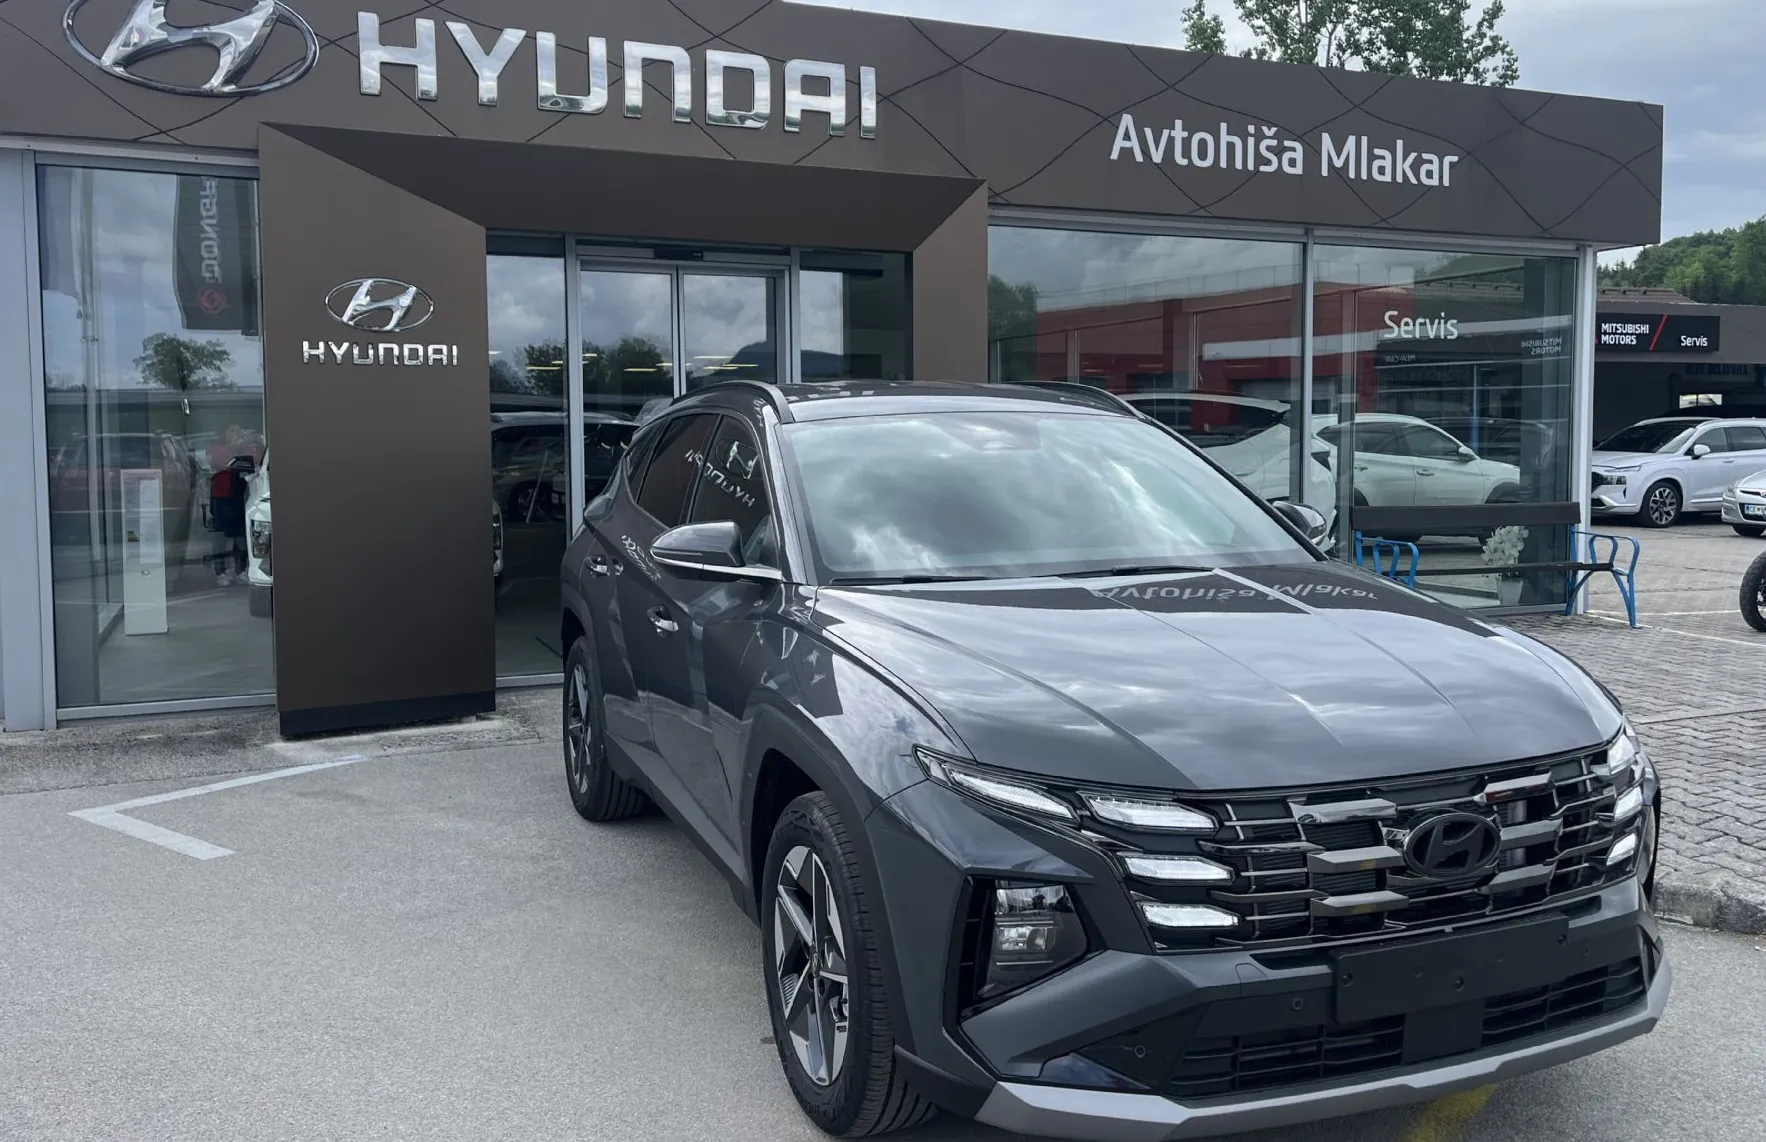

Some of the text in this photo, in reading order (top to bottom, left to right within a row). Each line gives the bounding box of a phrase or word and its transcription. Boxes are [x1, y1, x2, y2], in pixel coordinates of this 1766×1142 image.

[357, 11, 877, 139] HYUNDAI
[1110, 113, 1459, 187] Avtohiša Mlakar
[1384, 310, 1459, 340] Servis
[1601, 323, 1649, 334] MITSUBISHI
[1601, 334, 1637, 345] MOTORS
[1680, 335, 1708, 347] Servis
[302, 340, 458, 366] HYUNDAI
